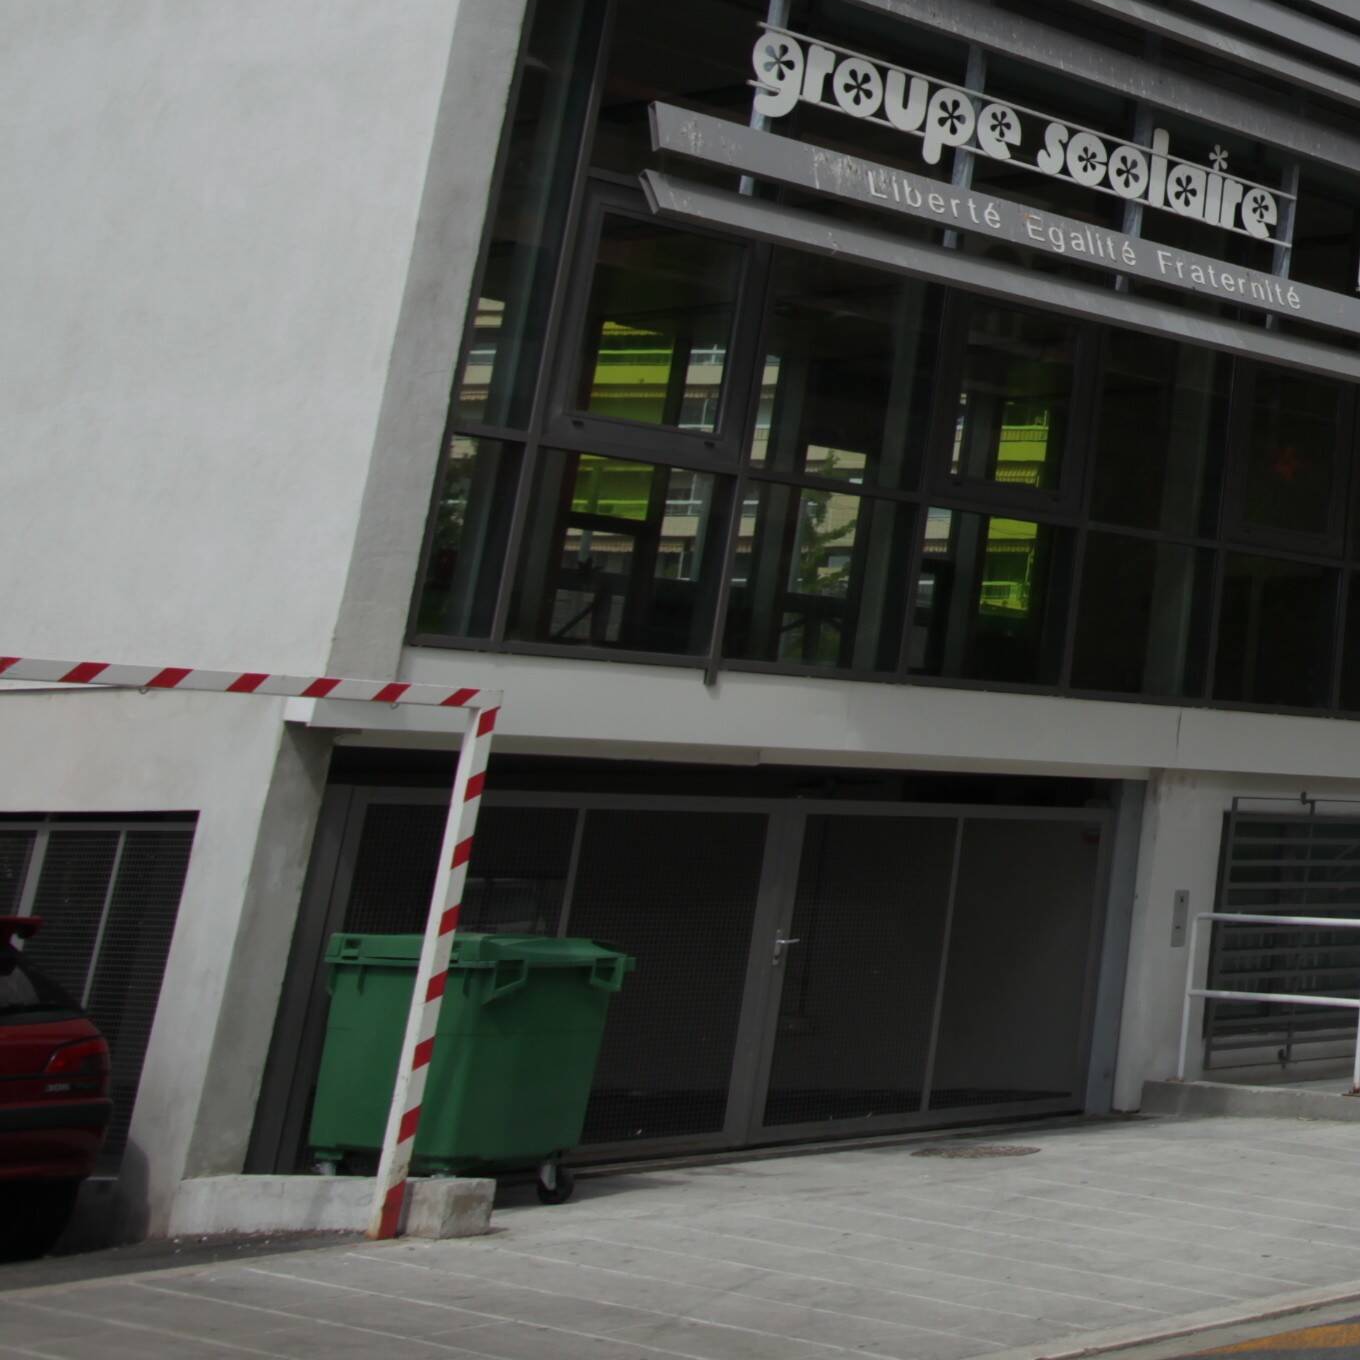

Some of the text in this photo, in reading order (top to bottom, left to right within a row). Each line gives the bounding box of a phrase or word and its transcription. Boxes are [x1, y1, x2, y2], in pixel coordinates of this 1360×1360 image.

[752, 31, 1279, 240] groupe scolaire
[867, 169, 1001, 229] Liberté
[1156, 250, 1301, 310] Fraternité
